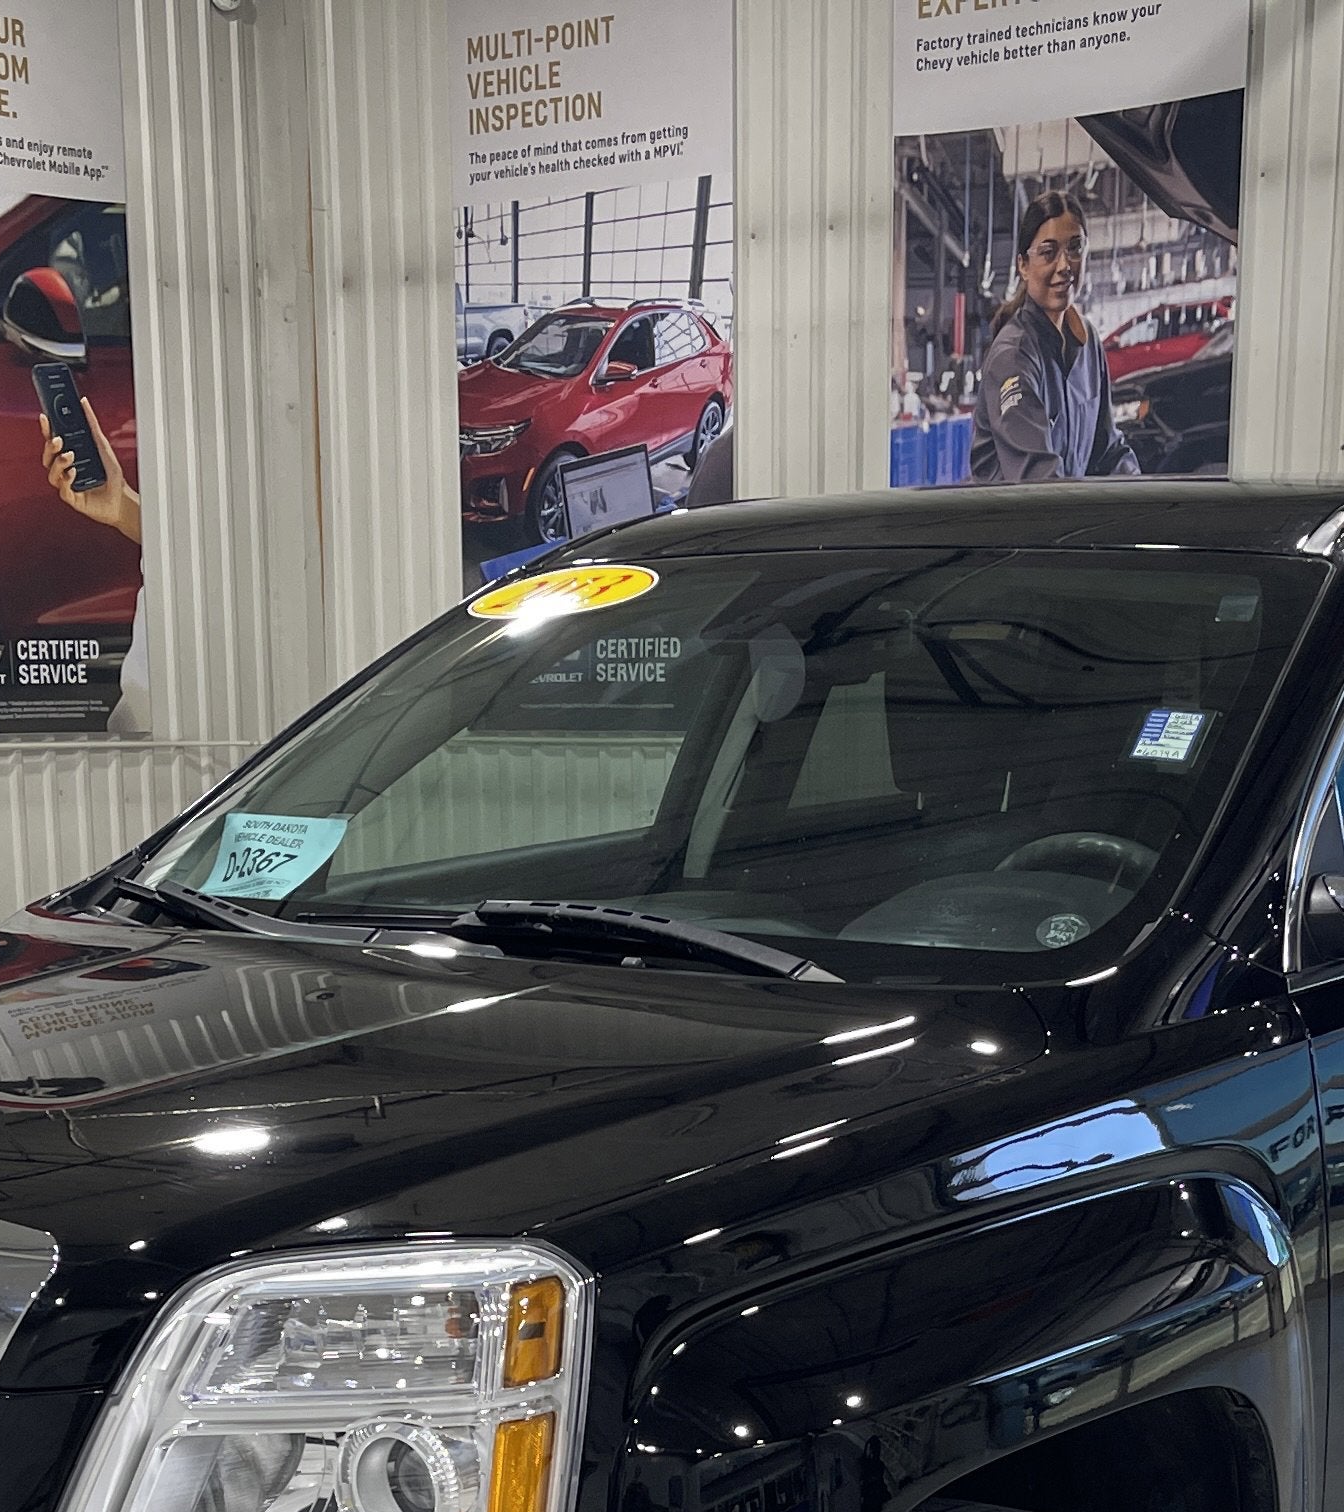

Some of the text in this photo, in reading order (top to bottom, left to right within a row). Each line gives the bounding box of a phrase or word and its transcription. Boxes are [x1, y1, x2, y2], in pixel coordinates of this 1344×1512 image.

[917, 3, 1162, 52] Factory trained technicians know your
[467, 15, 615, 65] MULTI-POINT
[916, 31, 1131, 72] Chevy vehicle better than anyone.
[467, 60, 561, 100] VEHICLE
[468, 91, 602, 136] INSPECTION
[5, 136, 25, 150] and
[27, 139, 55, 158] enjoy
[56, 144, 93, 160] remote
[468, 126, 689, 166] The peace of mind that comes from getting
[48, 159, 81, 177] Mobile
[469, 171, 491, 186] your
[493, 163, 536, 179] vehicle's
[538, 158, 570, 175] health
[573, 152, 616, 170] checked
[618, 149, 642, 164] with
[644, 149, 651, 161] a
[16, 639, 100, 660] CERTIFIED
[596, 637, 681, 659] CERTIFIED
[18, 663, 88, 684] SERVICE
[530, 672, 584, 684] EVROLET
[596, 662, 666, 682] SERVICE
[242, 819, 309, 834] SOUTH DAKOTA
[234, 832, 305, 849] VEHICLE DEALER
